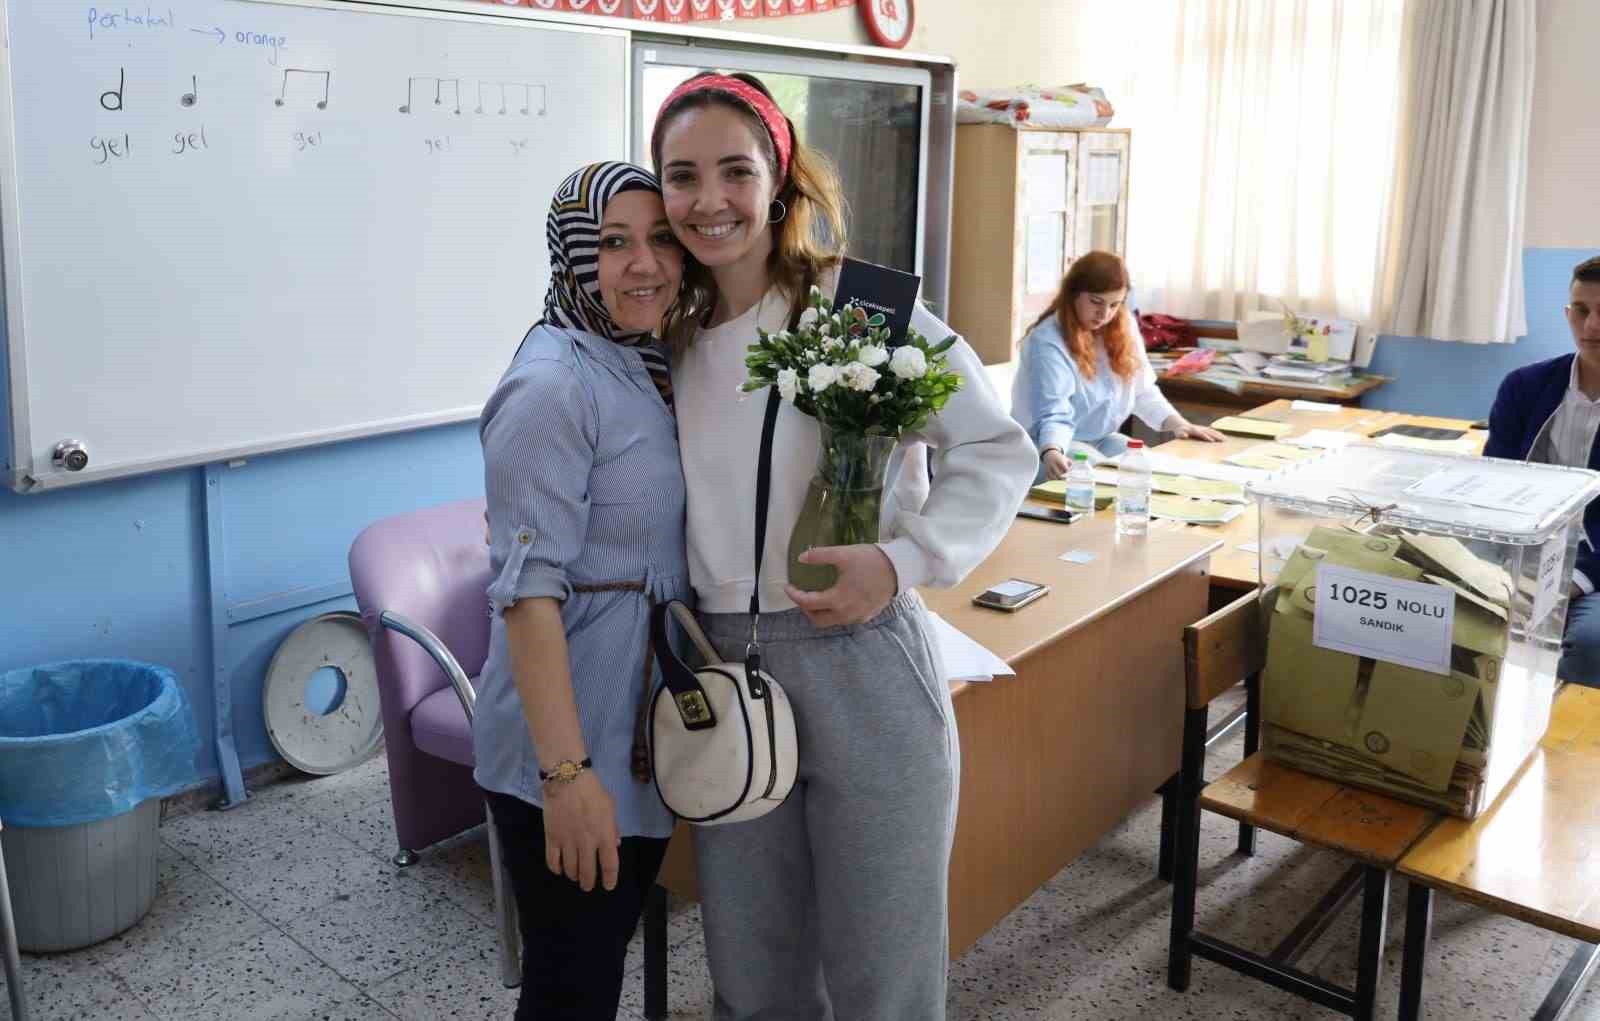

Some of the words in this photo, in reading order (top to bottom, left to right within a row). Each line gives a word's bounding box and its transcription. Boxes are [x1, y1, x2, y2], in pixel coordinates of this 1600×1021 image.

[235, 31, 288, 66] orange
[89, 132, 130, 164] gel
[173, 122, 208, 154] gel
[294, 130, 322, 152] gel
[1330, 583, 1388, 610] 1025
[1396, 599, 1446, 619] NOLU
[1359, 616, 1405, 633] SANDIK
